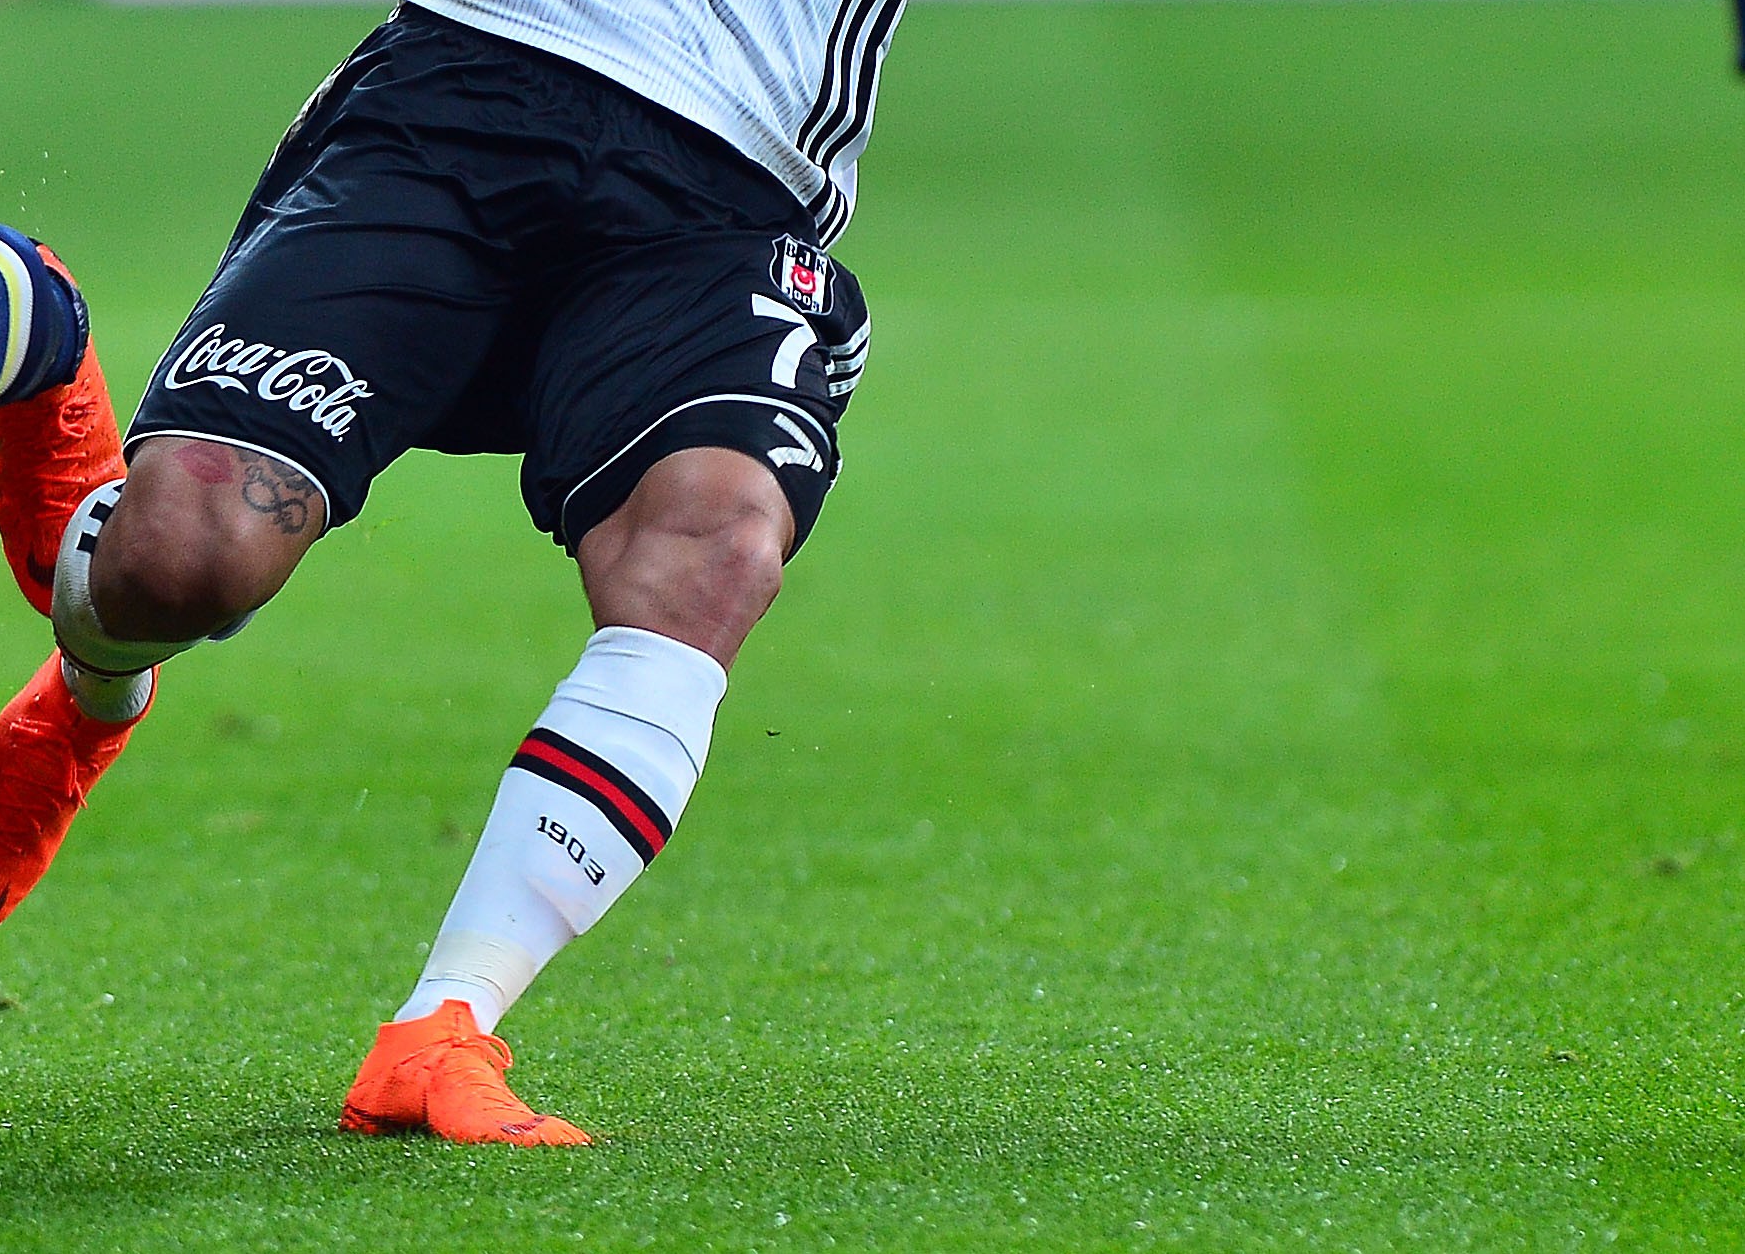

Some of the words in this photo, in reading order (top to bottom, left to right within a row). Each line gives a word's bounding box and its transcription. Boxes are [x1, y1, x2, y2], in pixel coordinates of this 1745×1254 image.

[164, 323, 375, 438] Coca-Cola
[751, 292, 818, 389] 7
[536, 815, 606, 887] 1903
